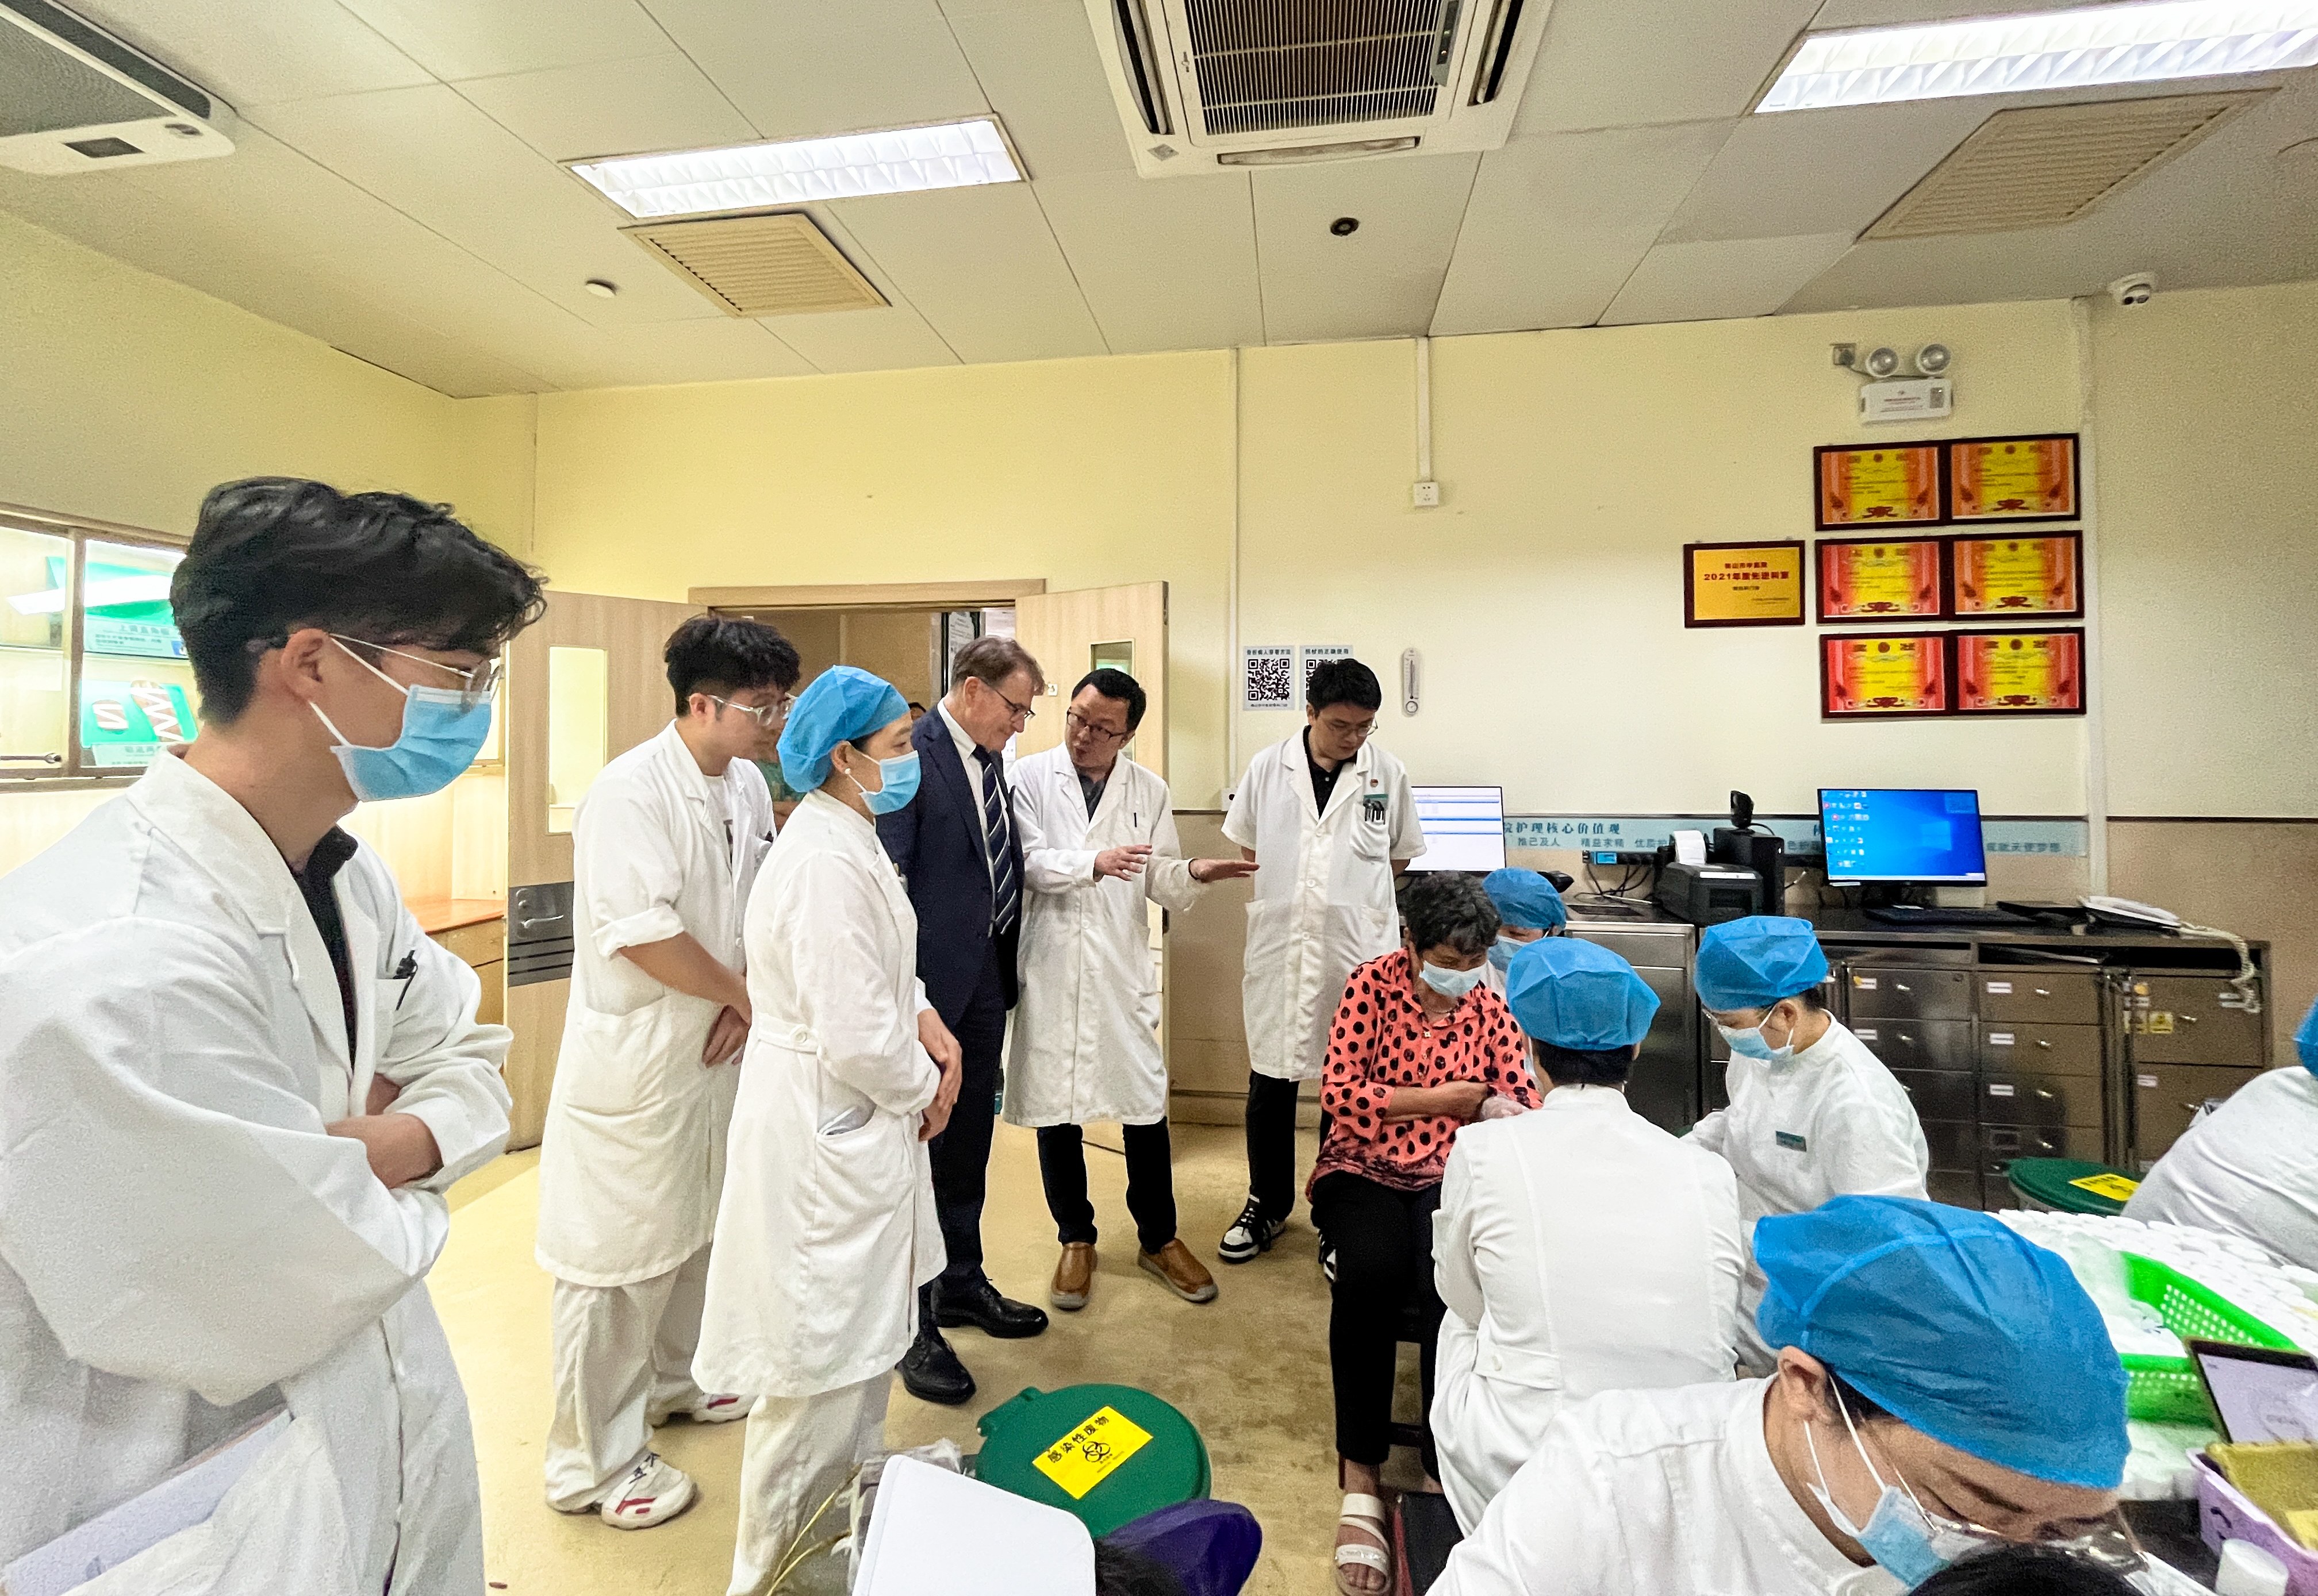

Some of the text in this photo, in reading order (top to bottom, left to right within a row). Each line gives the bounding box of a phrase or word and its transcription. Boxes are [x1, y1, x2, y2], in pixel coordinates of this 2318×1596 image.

[1582, 838, 1624, 848] 精益求精
[1047, 1416, 1110, 1463] 感染性废物
